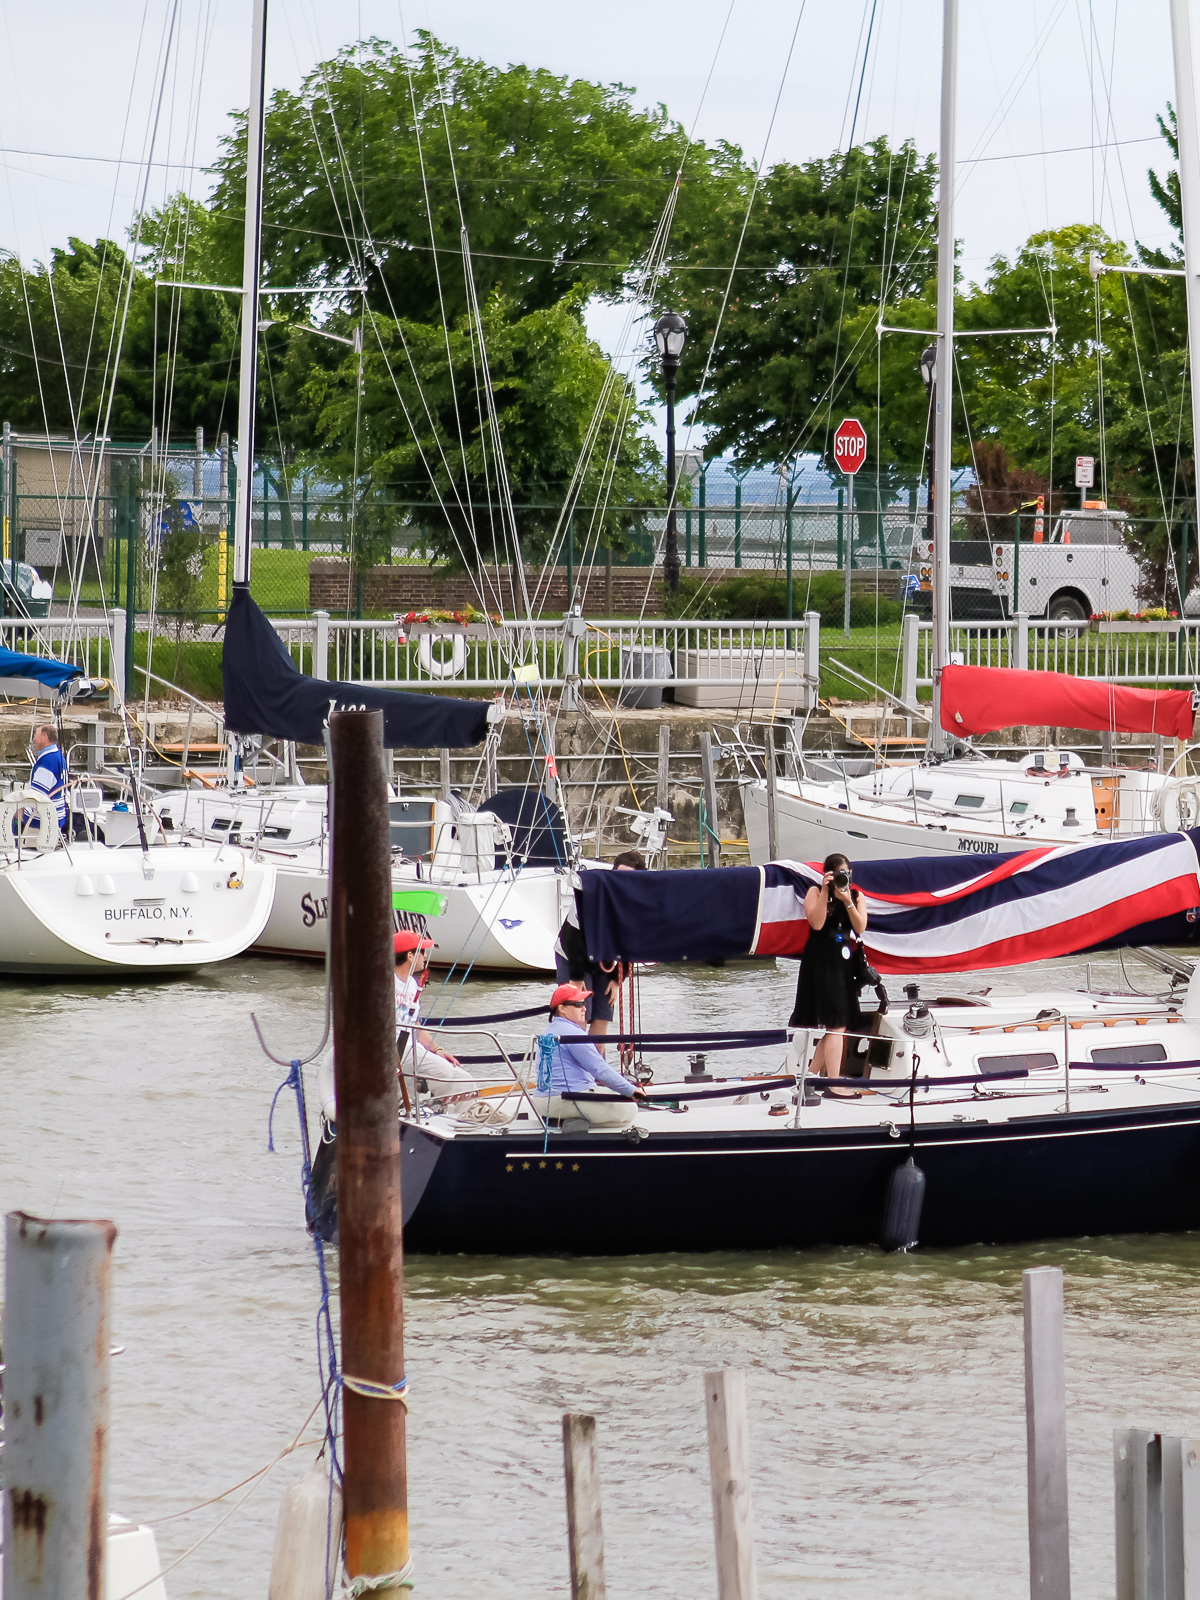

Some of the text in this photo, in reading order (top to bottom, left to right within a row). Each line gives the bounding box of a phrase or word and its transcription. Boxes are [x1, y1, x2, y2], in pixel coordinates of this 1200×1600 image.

[836, 436, 864, 457] STOP
[104, 906, 193, 921] BUFFALO, N.Y.
